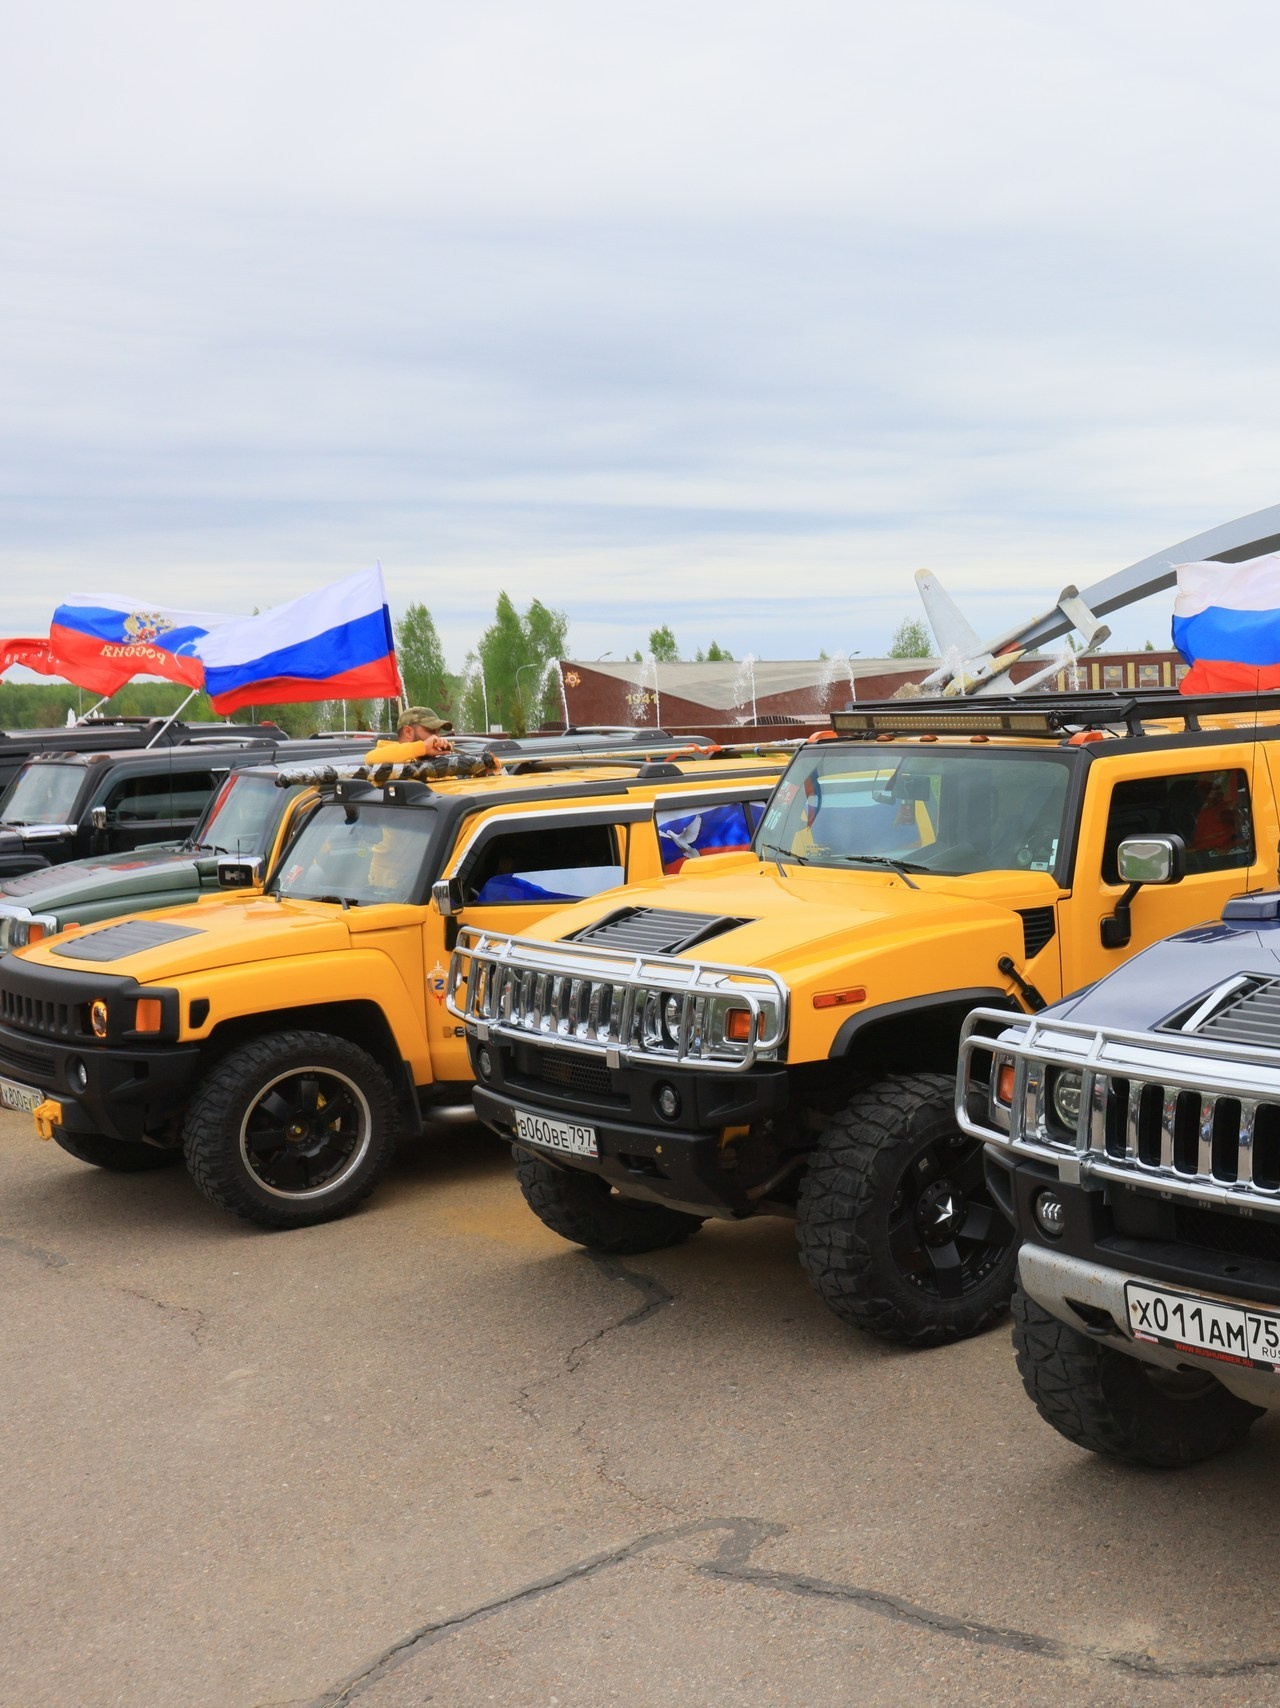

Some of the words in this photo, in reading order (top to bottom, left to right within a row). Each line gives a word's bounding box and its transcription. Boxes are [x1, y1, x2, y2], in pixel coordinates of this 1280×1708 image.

[569, 1126, 591, 1147] 797
[578, 1145, 590, 1154] RUS
[1136, 1297, 1245, 1352] Х011АМ
